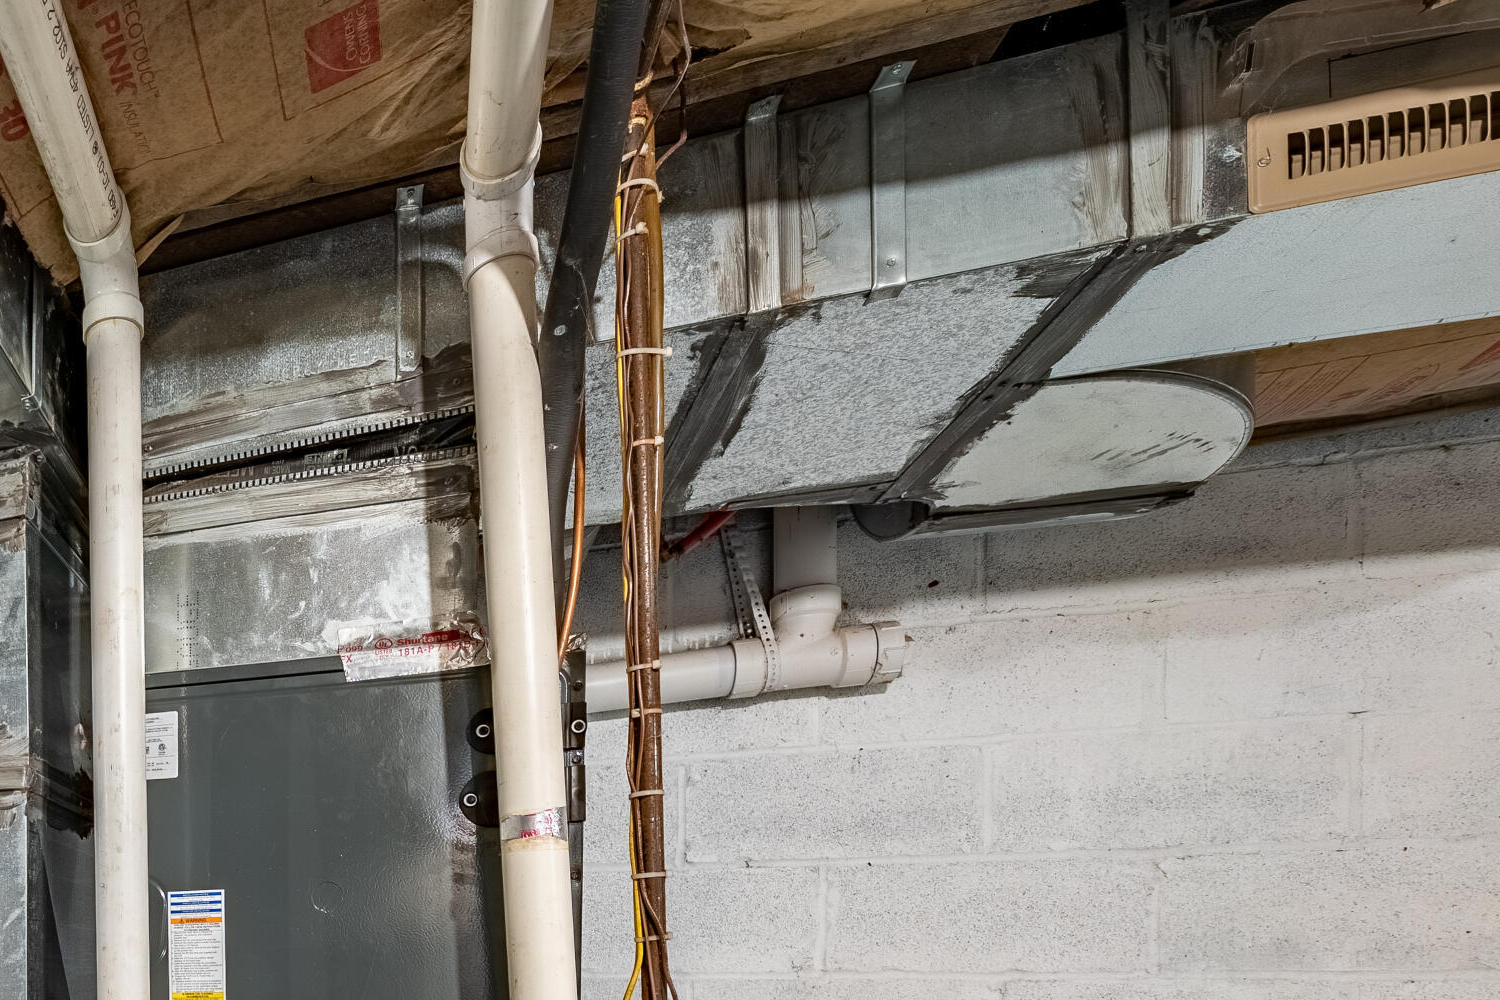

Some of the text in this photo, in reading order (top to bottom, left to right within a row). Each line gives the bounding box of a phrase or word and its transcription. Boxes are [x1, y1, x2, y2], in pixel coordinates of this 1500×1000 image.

[95, 10, 138, 96] PINK
[343, 11, 358, 61] OWENS
[356, 4, 371, 64] CORNING
[77, 94, 96, 143] LISTED
